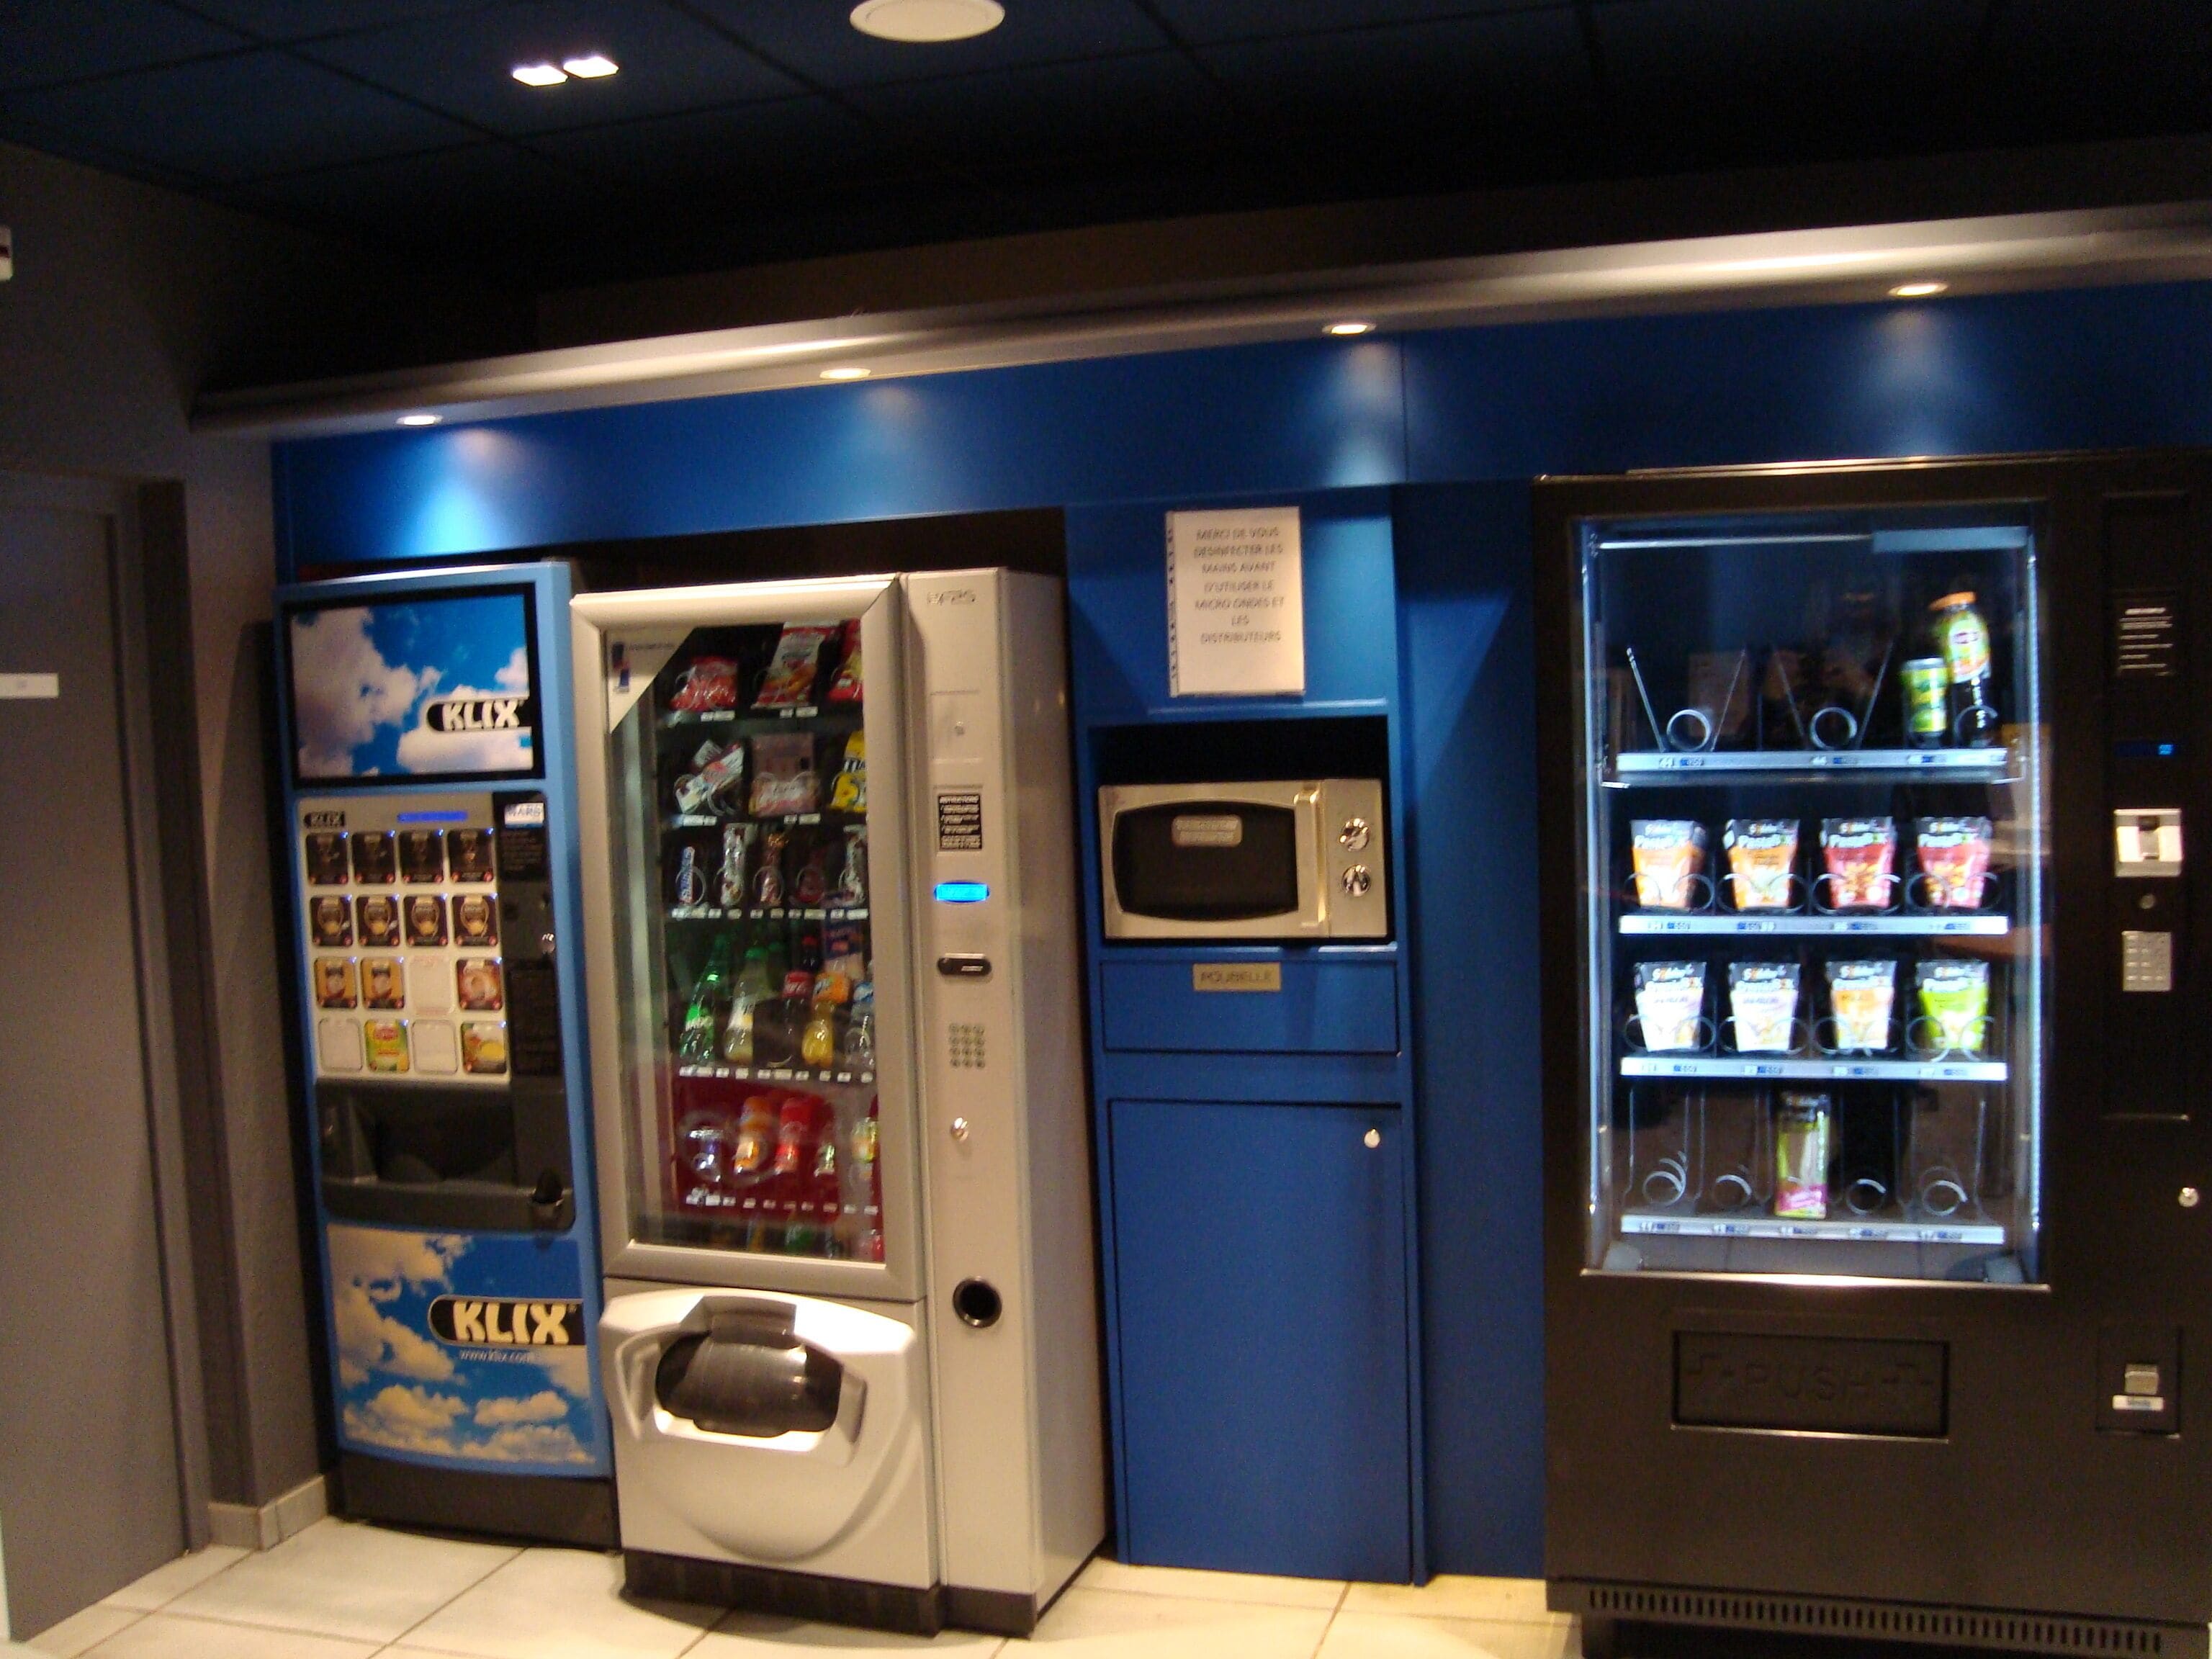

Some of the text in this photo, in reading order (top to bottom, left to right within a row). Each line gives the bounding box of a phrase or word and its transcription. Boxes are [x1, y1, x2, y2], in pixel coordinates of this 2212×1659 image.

[1239, 561, 1277, 572] AVANT
[1231, 614, 1250, 626] LES
[441, 698, 520, 732] KLIX
[452, 1300, 570, 1345] KLIX
